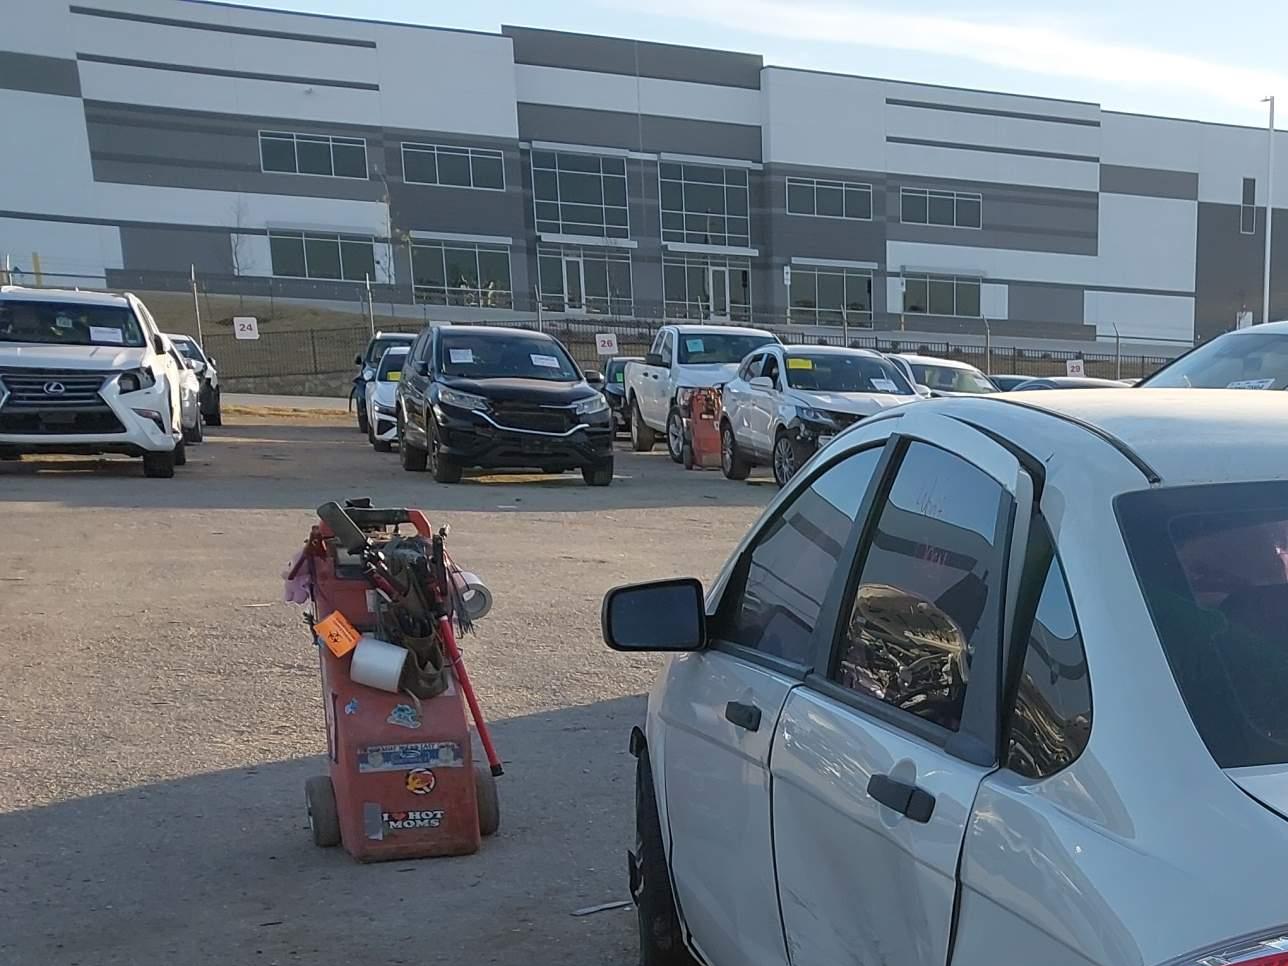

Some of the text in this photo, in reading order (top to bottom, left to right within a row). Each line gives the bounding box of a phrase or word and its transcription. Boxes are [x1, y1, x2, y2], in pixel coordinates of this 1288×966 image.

[239, 323, 253, 332] 24
[600, 340, 613, 348] 26
[408, 810, 444, 820] HOT
[389, 819, 440, 829] MOMS
